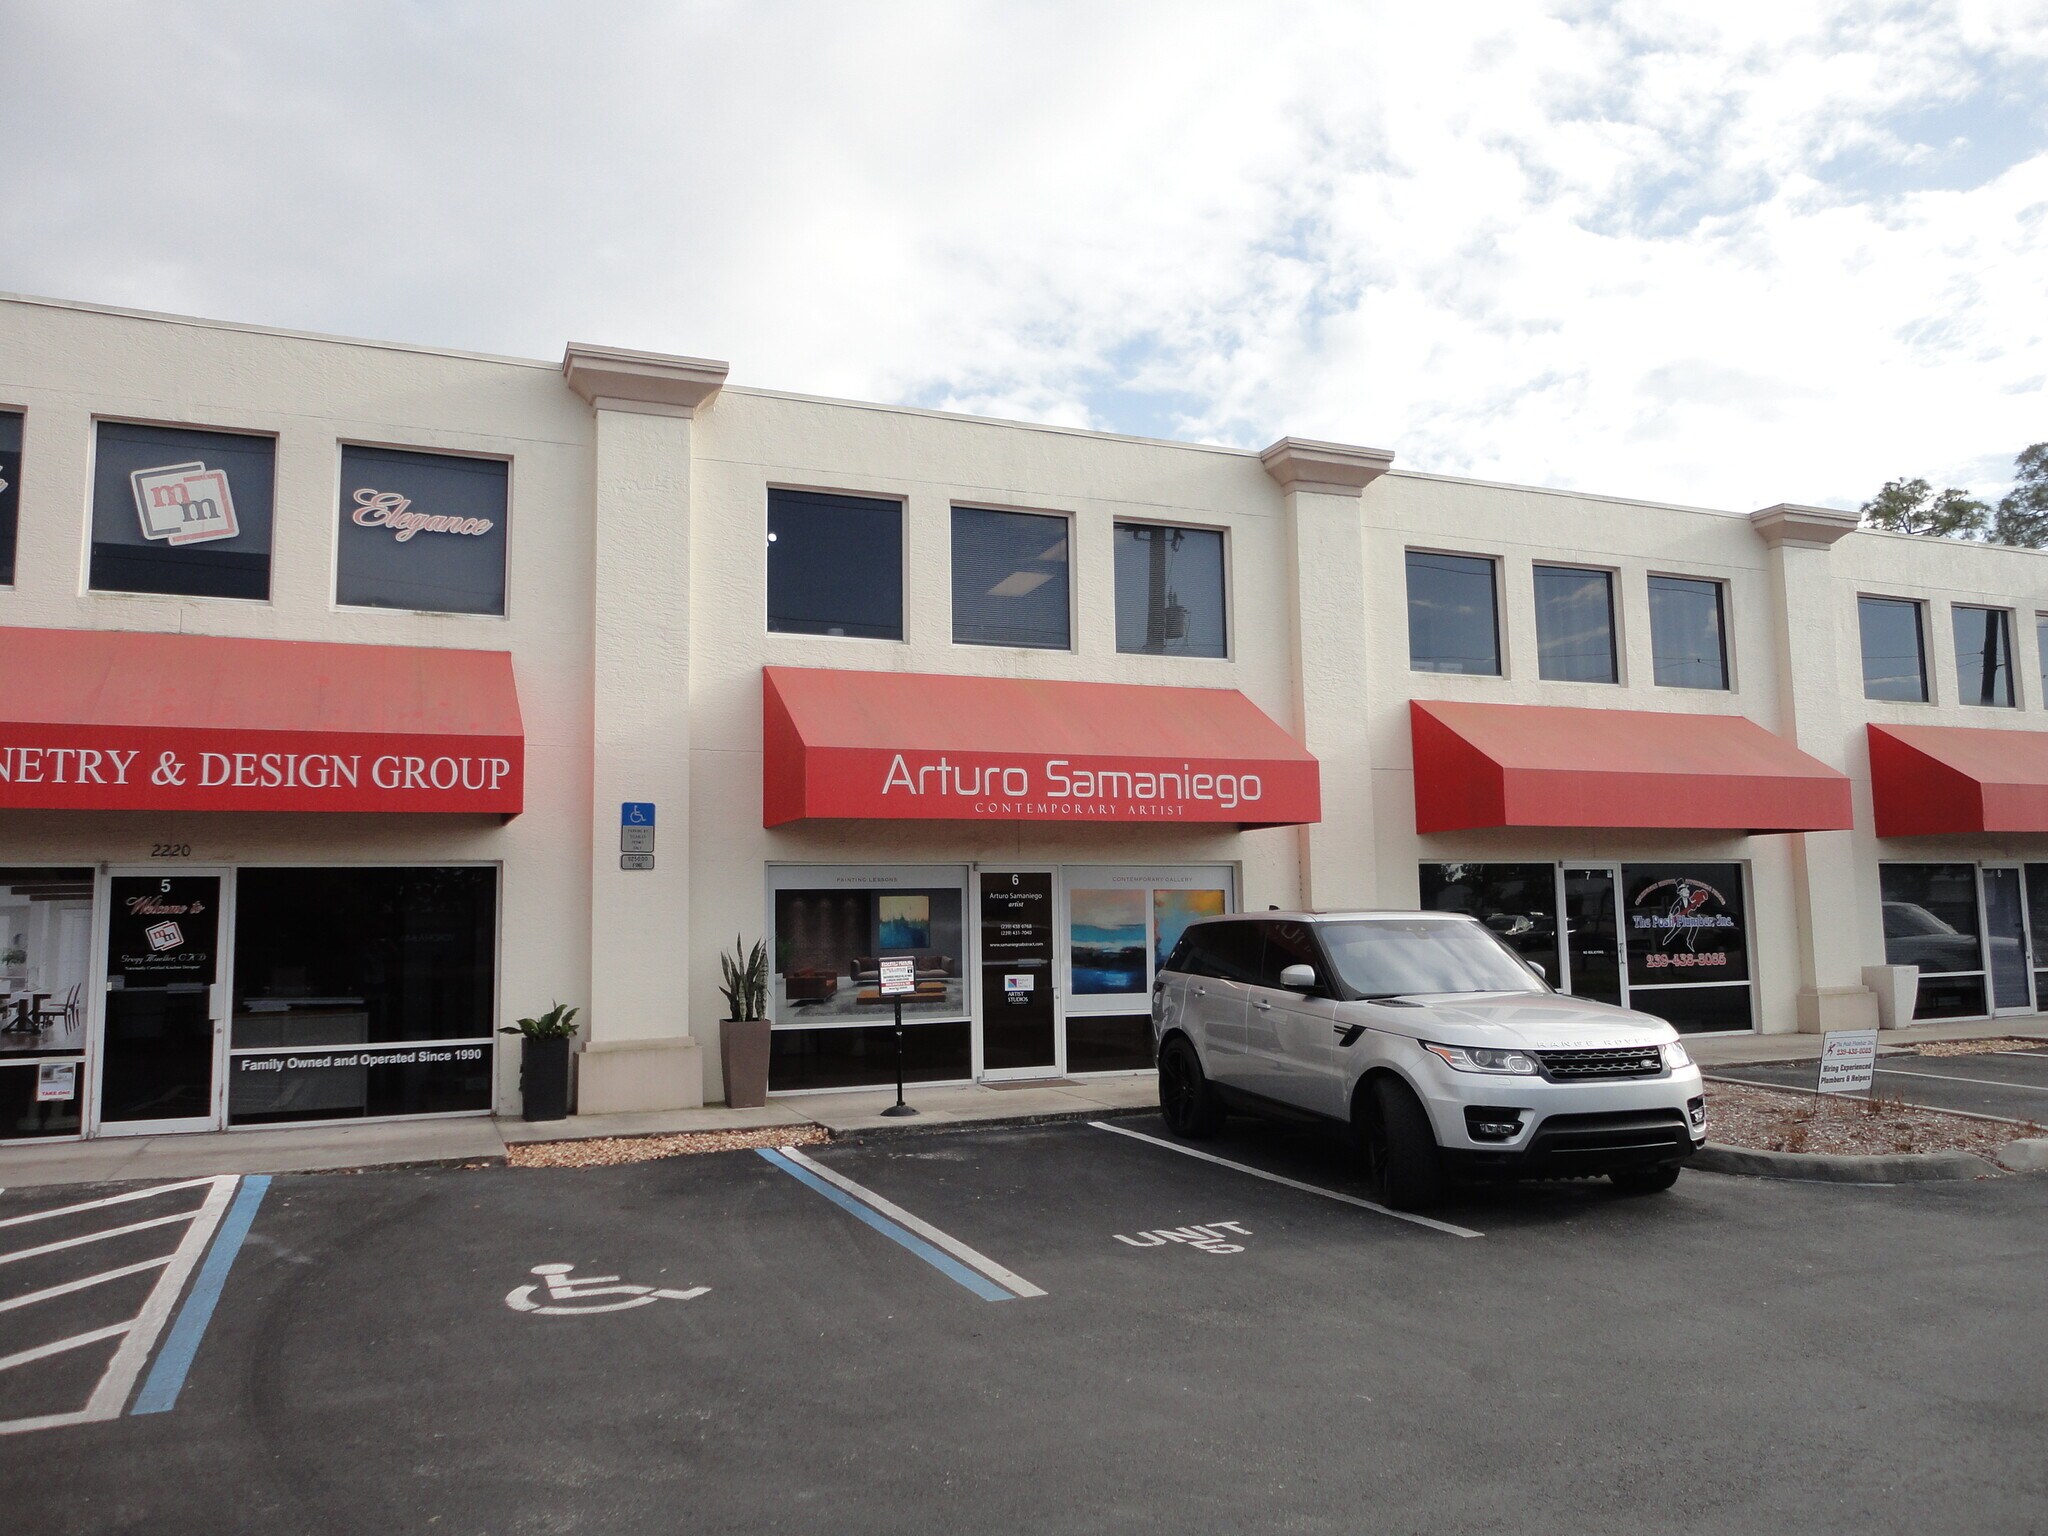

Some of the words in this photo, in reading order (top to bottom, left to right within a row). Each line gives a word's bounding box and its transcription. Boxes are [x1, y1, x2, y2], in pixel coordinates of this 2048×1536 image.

[353, 488, 494, 542] Elegance
[0, 747, 140, 785] NETRY
[151, 751, 187, 786] &
[198, 752, 362, 788] DESIGN
[372, 755, 510, 790] GROUP
[882, 754, 1029, 796] Arturo
[1046, 760, 1262, 809] Samaniego
[975, 802, 1117, 815] CONTEMPORARY
[1128, 805, 1184, 815] ARTIST
[151, 844, 191, 857] 2220
[1012, 874, 1019, 886] 6
[1585, 871, 1591, 880] 7
[161, 879, 171, 893] 5
[1009, 892, 1043, 900] Samaniego
[125, 894, 189, 916] Welcome
[189, 900, 206, 915] to
[1633, 914, 1651, 928] The
[1651, 914, 1676, 928] Posh
[1676, 913, 1715, 928] Plumber,
[1715, 913, 1735, 927] Inc.
[1536, 1040, 1593, 1048] RANGE
[1603, 1037, 1652, 1046] ROVER
[241, 1059, 285, 1072] Family
[287, 1056, 332, 1069] Owned
[333, 1054, 358, 1067] and
[360, 1052, 415, 1067] Operated
[418, 1050, 451, 1063] Since
[454, 1049, 482, 1060] 1990
[1823, 1065, 1839, 1073] Hiring
[1840, 1063, 1871, 1072] Experienced
[1821, 1076, 1845, 1084] Plumbers
[1112, 1221, 1253, 1247] UNIT
